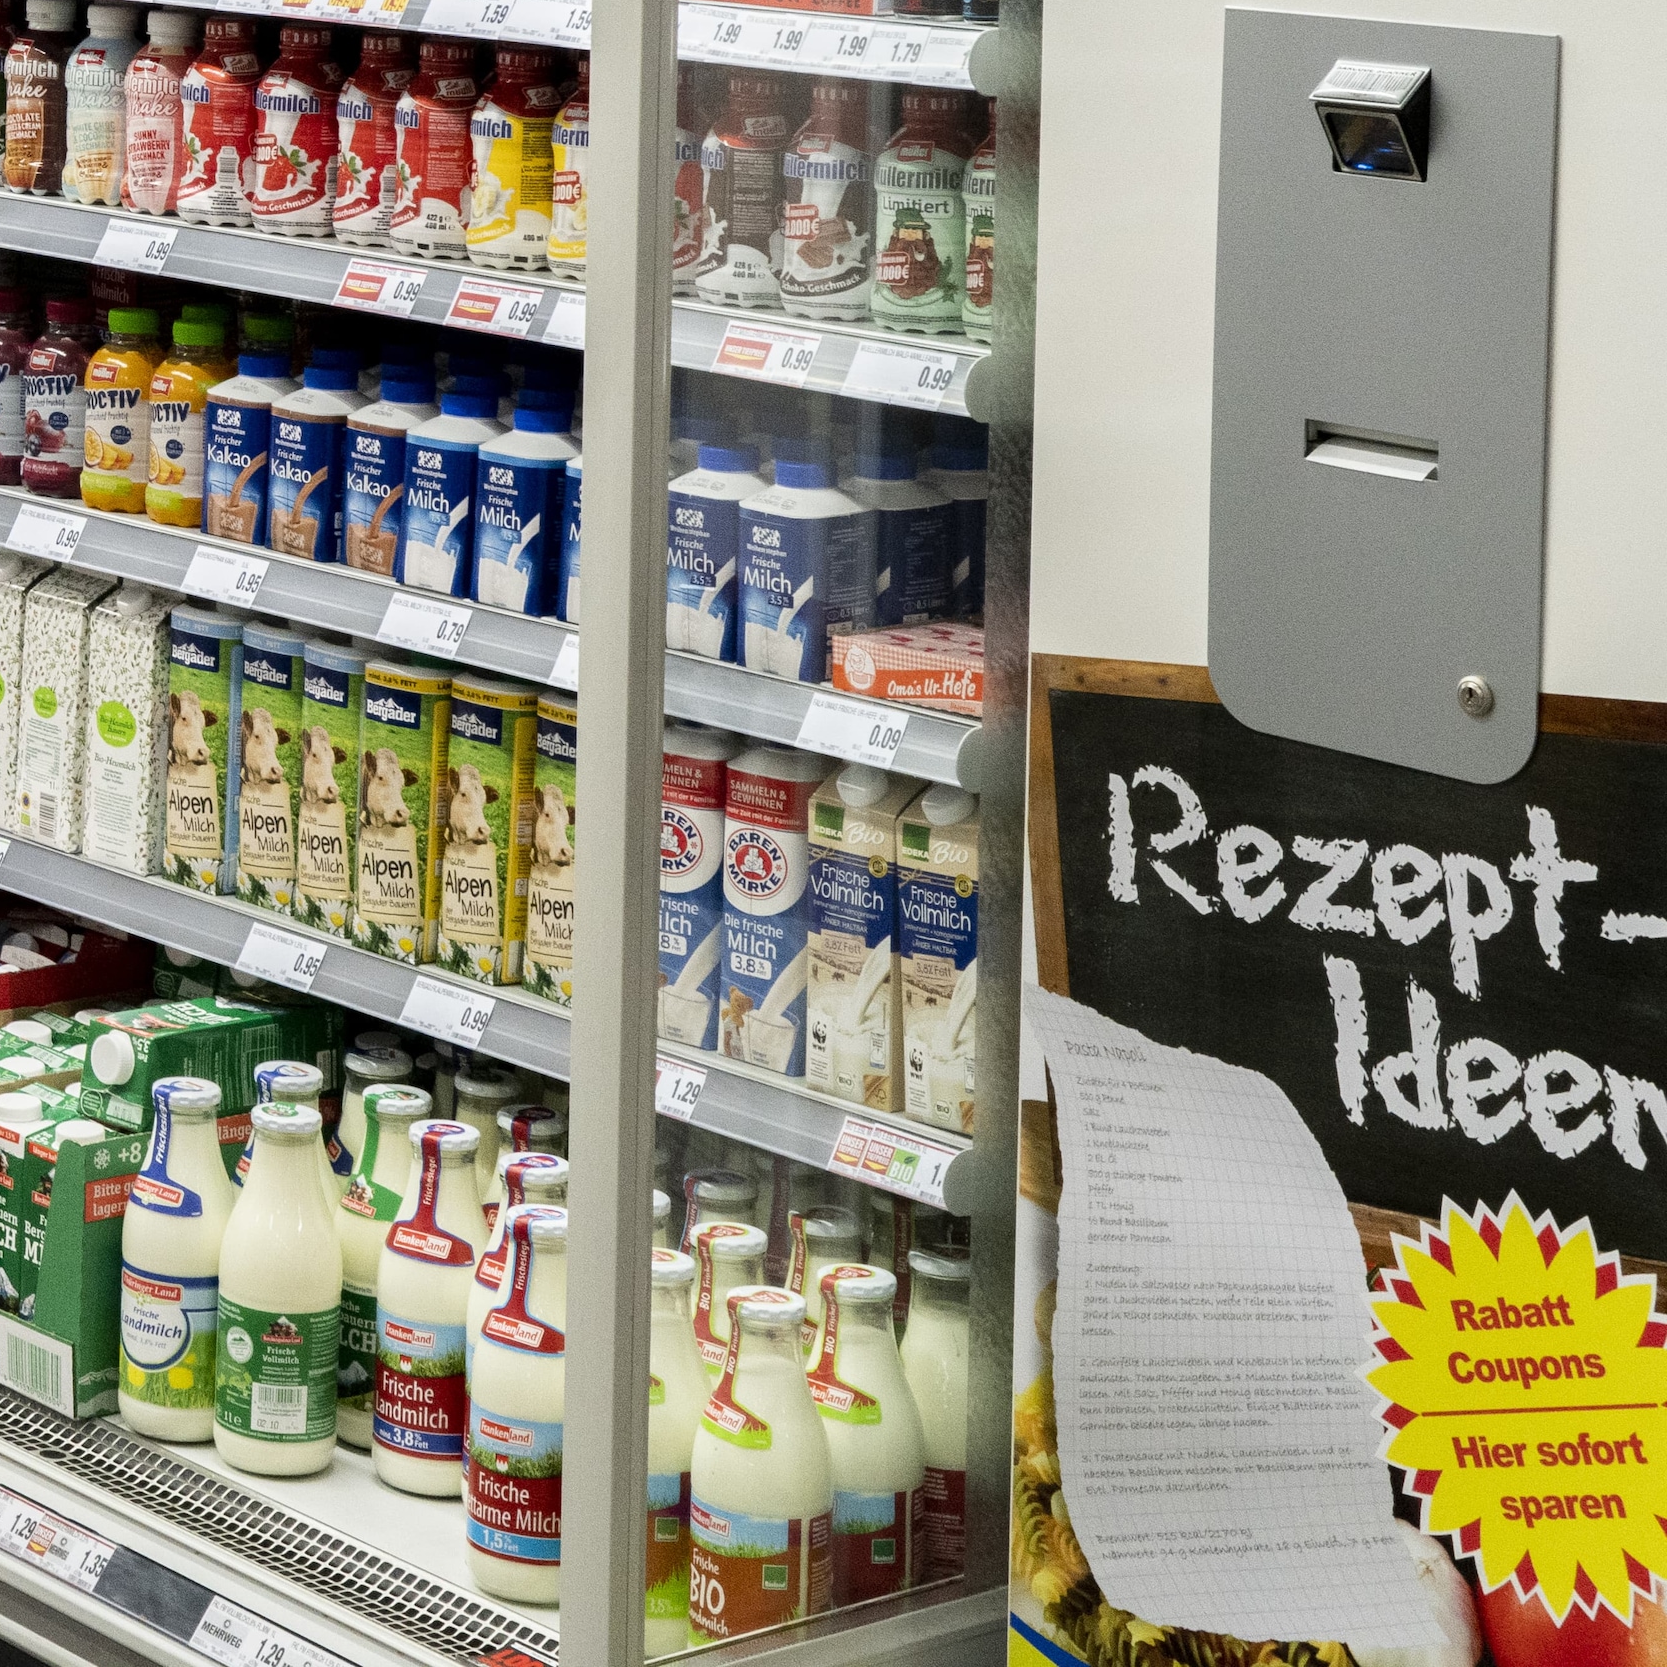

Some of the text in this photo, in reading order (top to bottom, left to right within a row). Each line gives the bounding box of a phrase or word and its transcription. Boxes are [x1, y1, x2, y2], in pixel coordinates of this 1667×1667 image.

[481, 3, 508, 23] 1.59
[713, 23, 741, 44] 1.99
[837, 35, 867, 57] 1.99
[891, 42, 921, 63] 1.79
[134, 130, 157, 139] SUNNY
[131, 151, 165, 162] GESCHMACK
[207, 444, 251, 467] Kakao
[347, 472, 390, 498] Kakao
[417, 477, 441, 490] Frische
[408, 489, 449, 513] Milch
[751, 556, 781, 570] Frische
[744, 568, 792, 594] Milch
[172, 646, 215, 668] Bergader
[924, 670, 976, 698] Ur-Hefe
[367, 699, 416, 724] Bergader
[869, 725, 900, 749] 0.09
[169, 790, 213, 814] Alpen
[730, 780, 787, 800] SAMMELN &
[731, 791, 784, 810] GEWINNEN
[184, 818, 215, 833] Milch
[361, 856, 413, 880] Alpen
[821, 862, 870, 887] Frische
[380, 883, 415, 899] Milch
[810, 875, 884, 912] Vollmilch
[1101, 764, 1667, 1002] Rezept-
[724, 913, 783, 939] Die frische
[728, 931, 777, 959] Milch
[1065, 1041, 1147, 1066] Pasta Napoli
[671, 1078, 701, 1106] 1.29
[1450, 1295, 1575, 1331] Rabatt
[262, 1352, 300, 1365] Vollmilch
[1448, 1351, 1606, 1389] Coupons
[382, 1372, 434, 1403] Frische
[375, 1399, 448, 1429] Landmilch
[1452, 1432, 1648, 1468] Hier sofort
[1500, 1494, 1626, 1528] sparen
[200, 1620, 243, 1649] MEHRWEG
